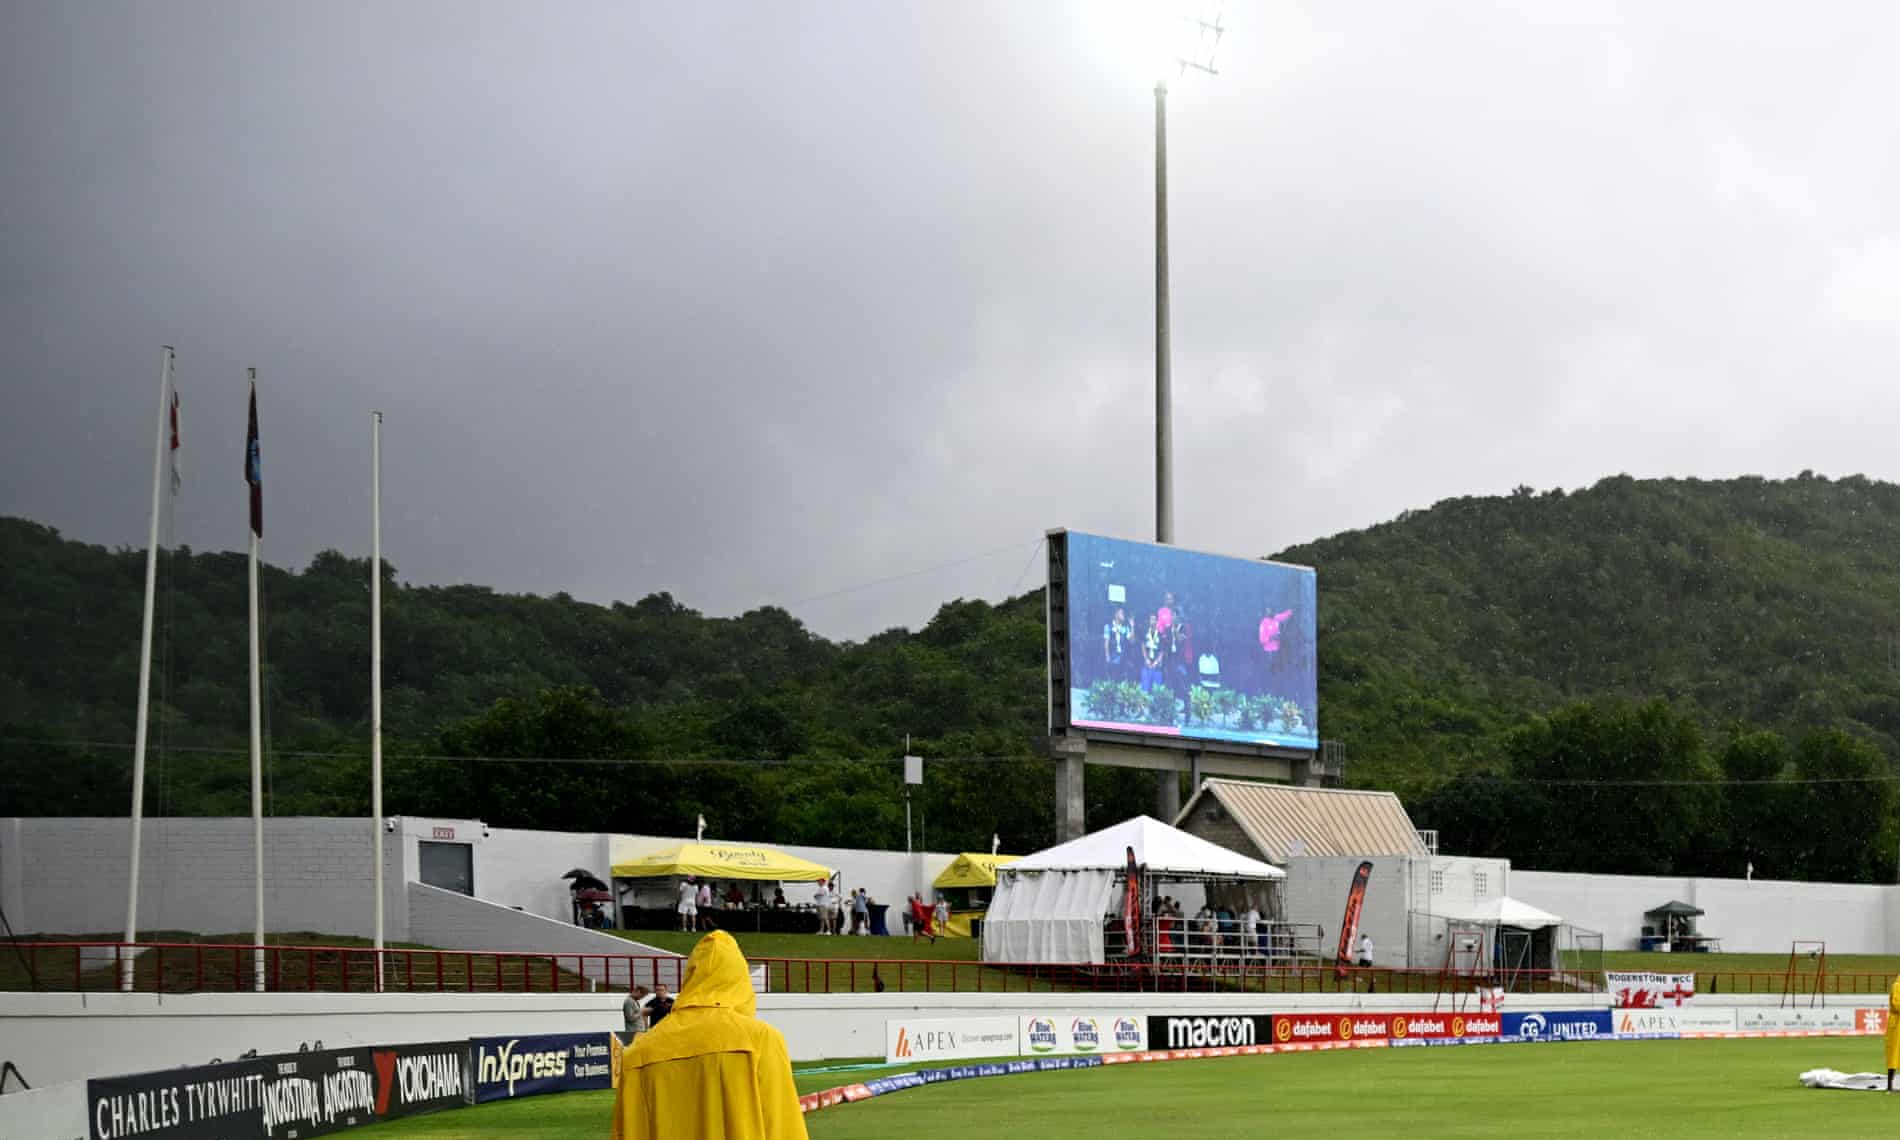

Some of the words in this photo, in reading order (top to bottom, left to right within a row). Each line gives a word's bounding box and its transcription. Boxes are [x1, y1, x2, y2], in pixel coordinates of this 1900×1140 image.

[1036, 1021, 1050, 1033] Blue
[1078, 1021, 1093, 1033] Blue
[1119, 1021, 1135, 1033] Blue
[1293, 1021, 1332, 1037] dafabet
[1354, 1021, 1387, 1035] dafabet
[1408, 1019, 1445, 1034] dafabet
[1465, 1018, 1498, 1034] dafabet
[1552, 1022, 1598, 1035] UNITED
[1638, 1014, 1678, 1030] APEX
[1030, 1031, 1057, 1045] WATERS
[1073, 1031, 1099, 1045] WATERS
[1116, 1031, 1141, 1045] WATERS
[1168, 1017, 1255, 1047] macron
[915, 1032, 956, 1051] APEX
[478, 1039, 566, 1097] InXpress
[396, 1052, 463, 1105] YOKOHAMA
[323, 1069, 375, 1124] ANGOSTURA
[97, 1087, 180, 1140] CHARLES
[185, 1075, 263, 1122] TYRWHITT
[262, 1077, 321, 1137] ANGOSTURA
